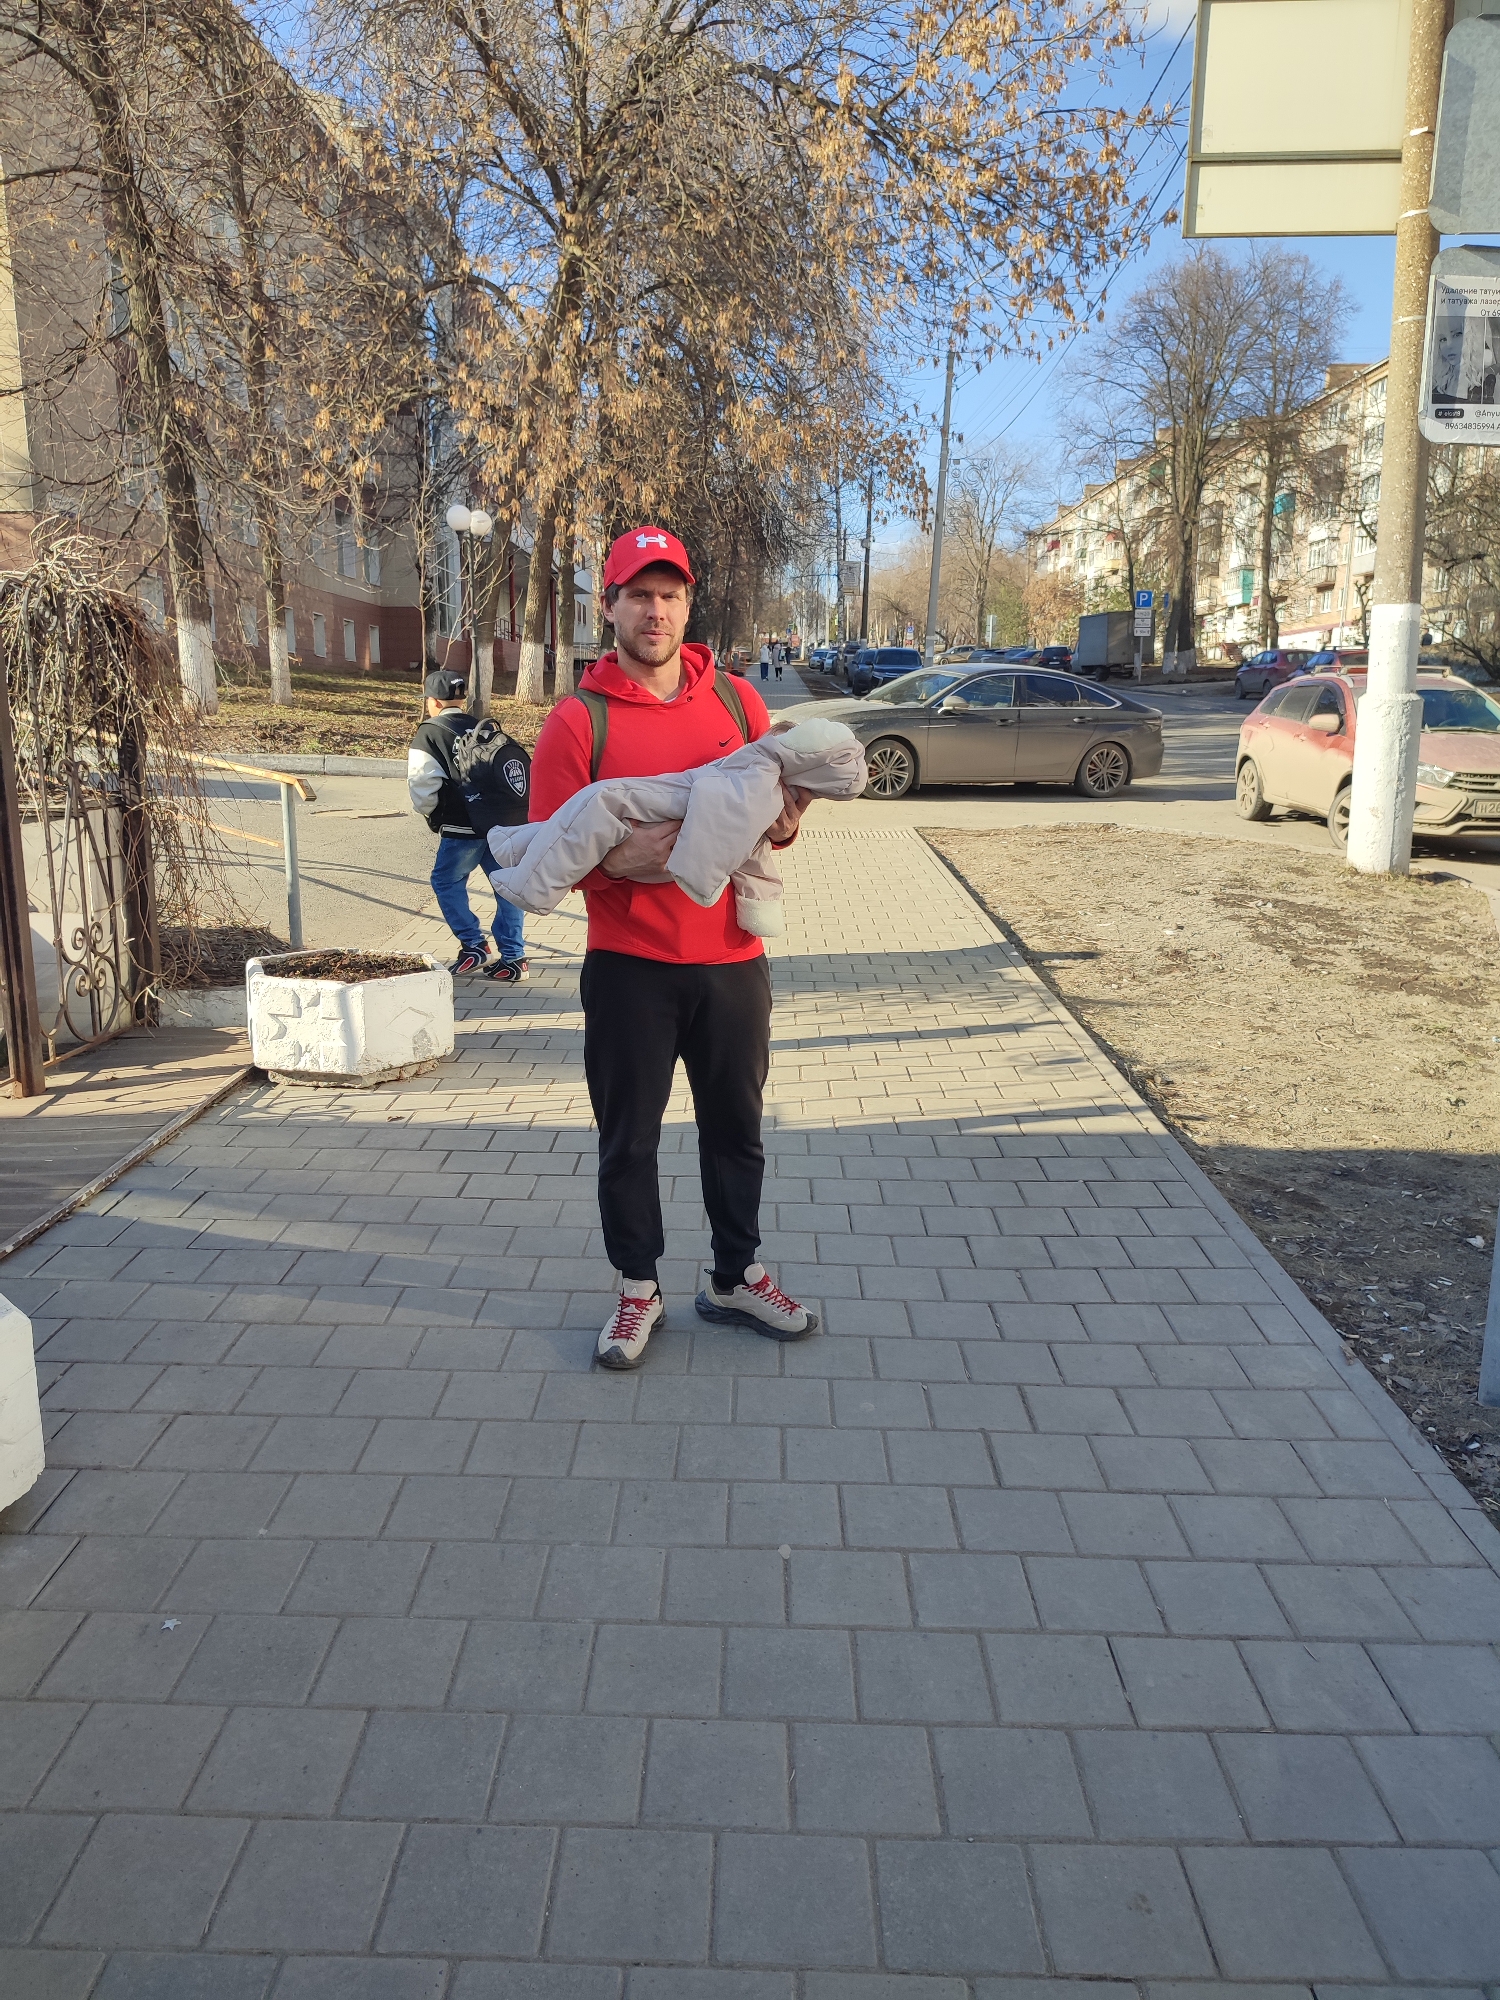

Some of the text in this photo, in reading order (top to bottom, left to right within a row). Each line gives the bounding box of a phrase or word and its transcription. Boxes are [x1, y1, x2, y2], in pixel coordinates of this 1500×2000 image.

[1441, 286, 1477, 295] Удаление
[1448, 298, 1477, 306] татуажа
[1480, 309, 1491, 317] От
[1445, 422, 1495, 430] 89634835994
[1140, 592, 1149, 606] P
